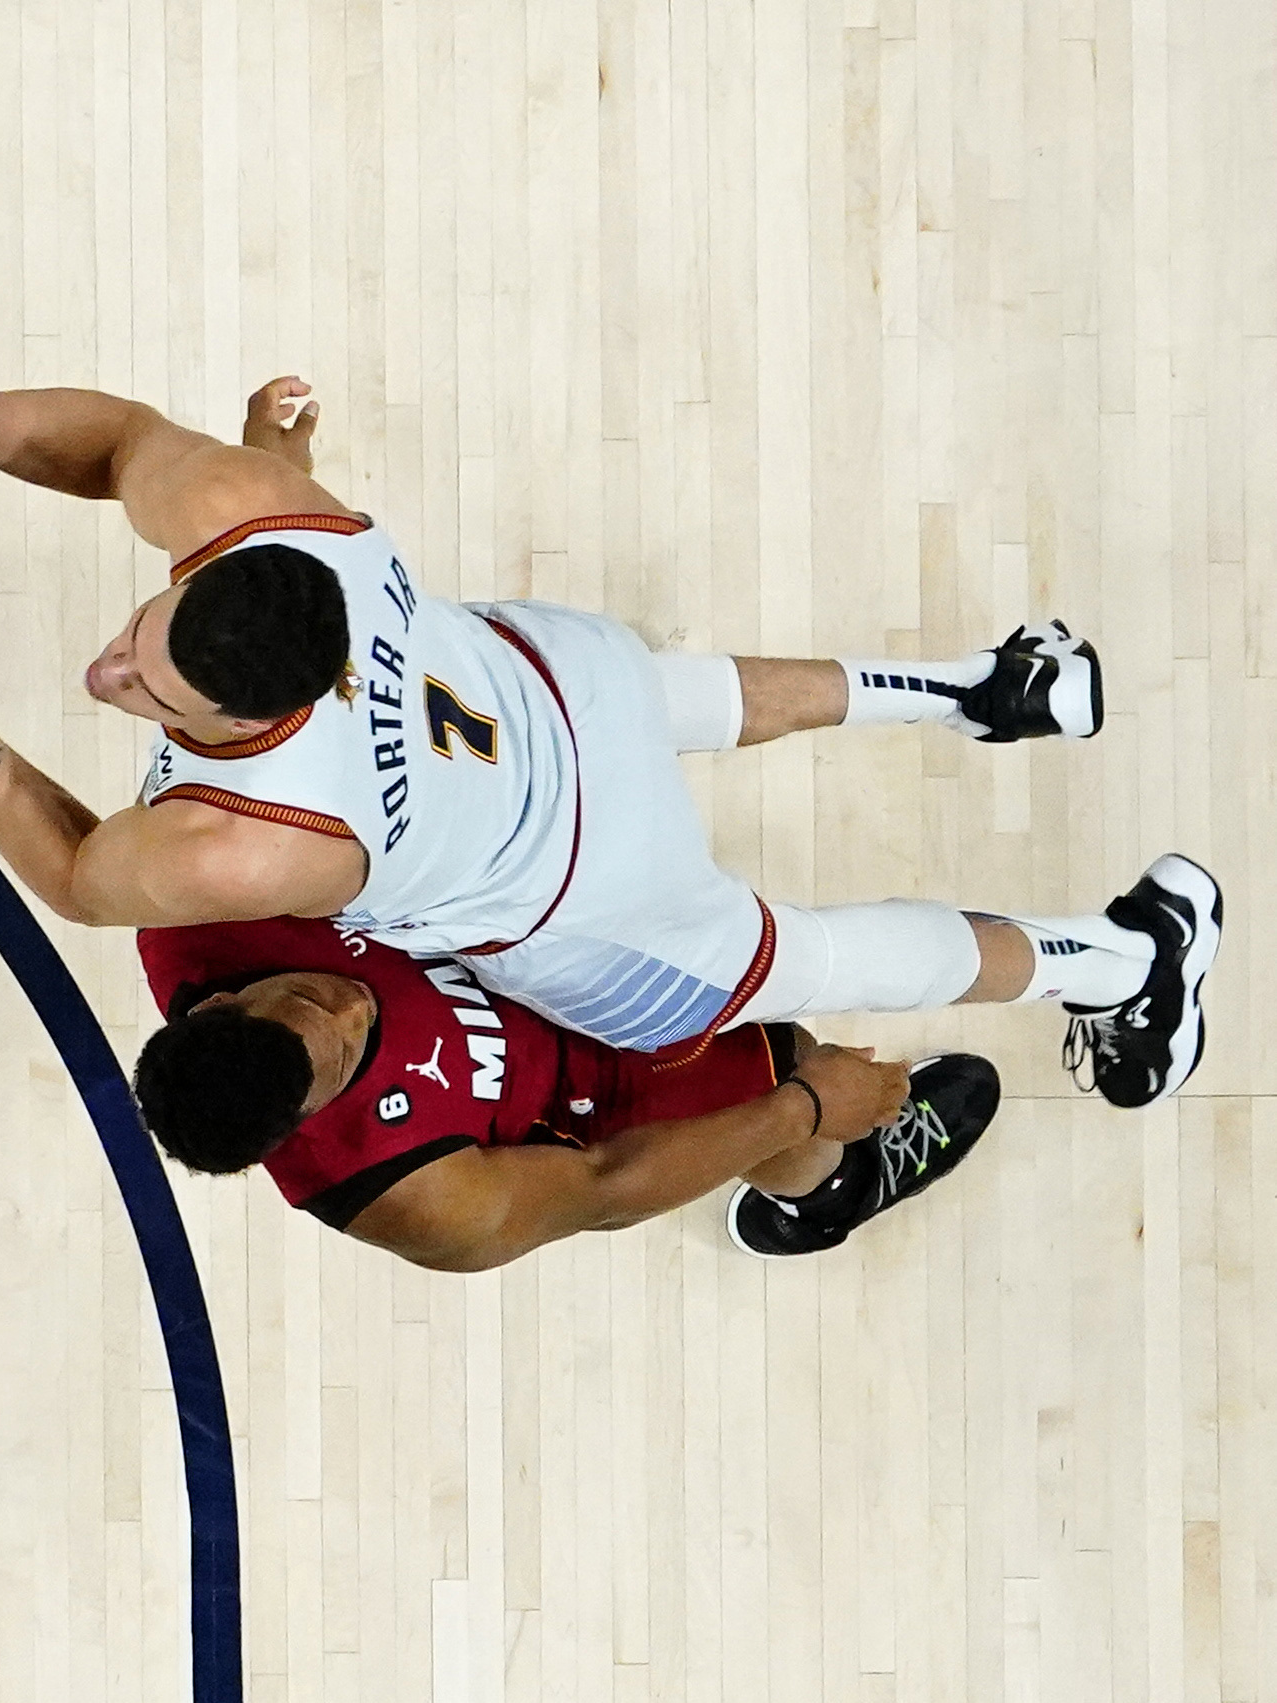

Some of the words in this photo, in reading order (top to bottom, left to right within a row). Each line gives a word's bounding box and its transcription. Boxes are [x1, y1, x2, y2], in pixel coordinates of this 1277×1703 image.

[369, 634, 411, 855] PORTER
[423, 672, 498, 765] 7
[424, 964, 506, 1100] MIA
[379, 1092, 410, 1121] 6
